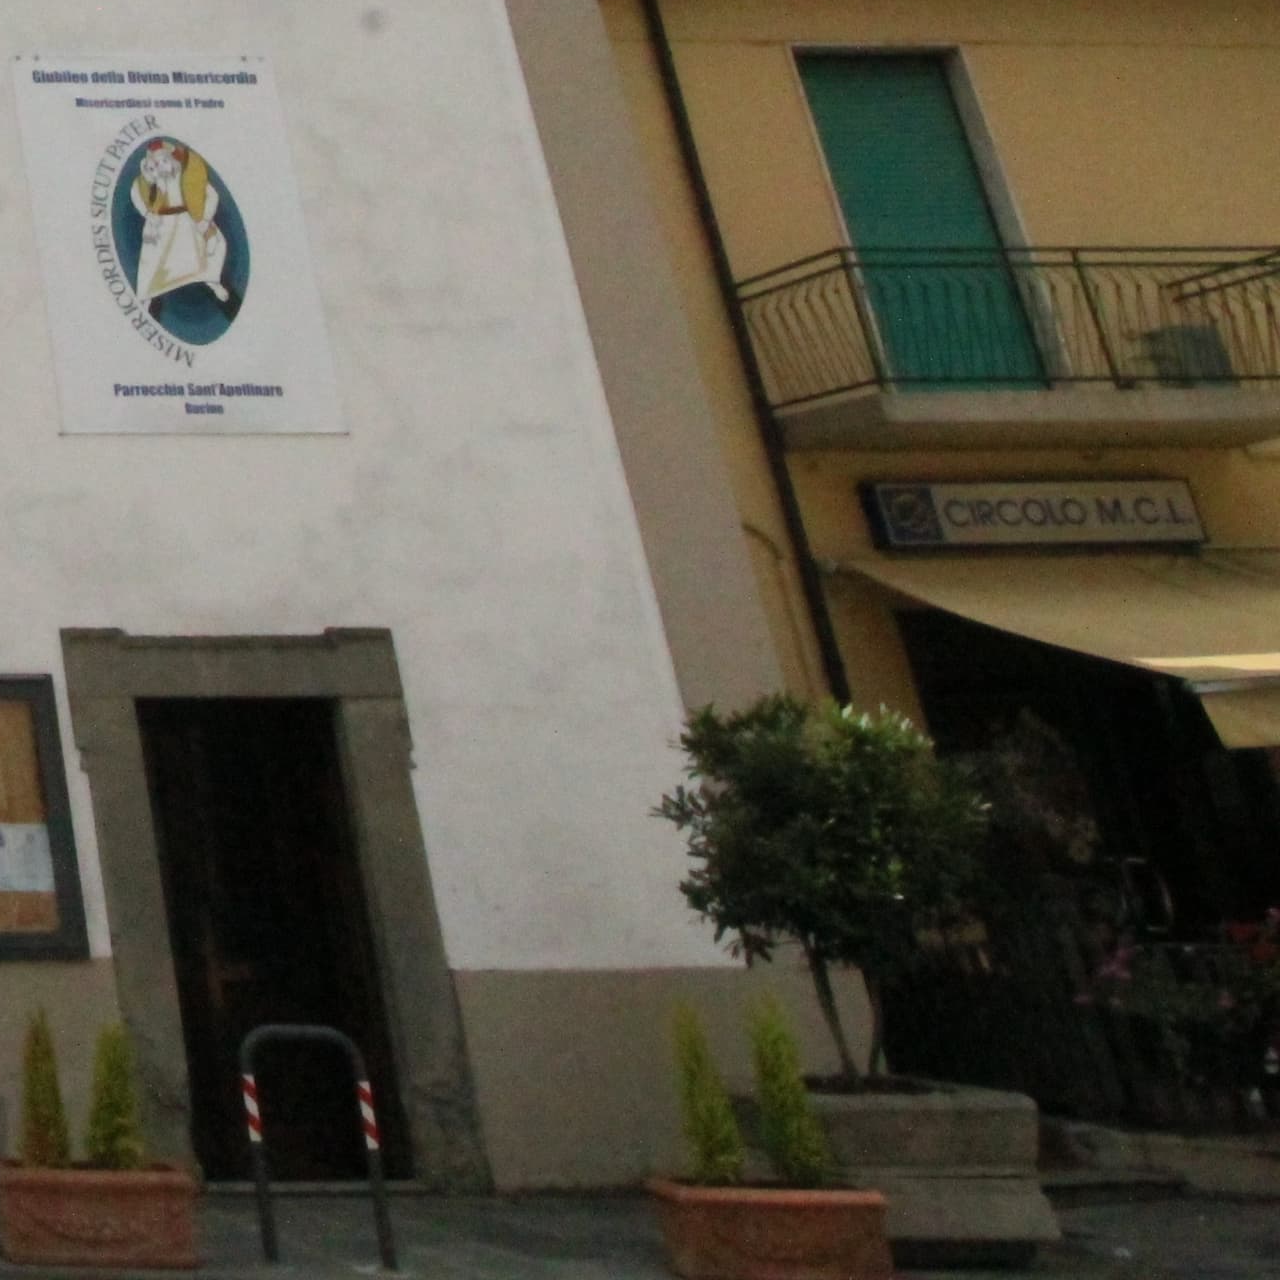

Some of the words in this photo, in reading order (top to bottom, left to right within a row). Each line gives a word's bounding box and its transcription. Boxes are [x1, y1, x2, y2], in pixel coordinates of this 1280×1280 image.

[105, 113, 160, 161] PATER
[90, 157, 116, 219] SICUT
[90, 224, 195, 368] MISERICORDES
[943, 496, 1088, 528] CIRCOLO
